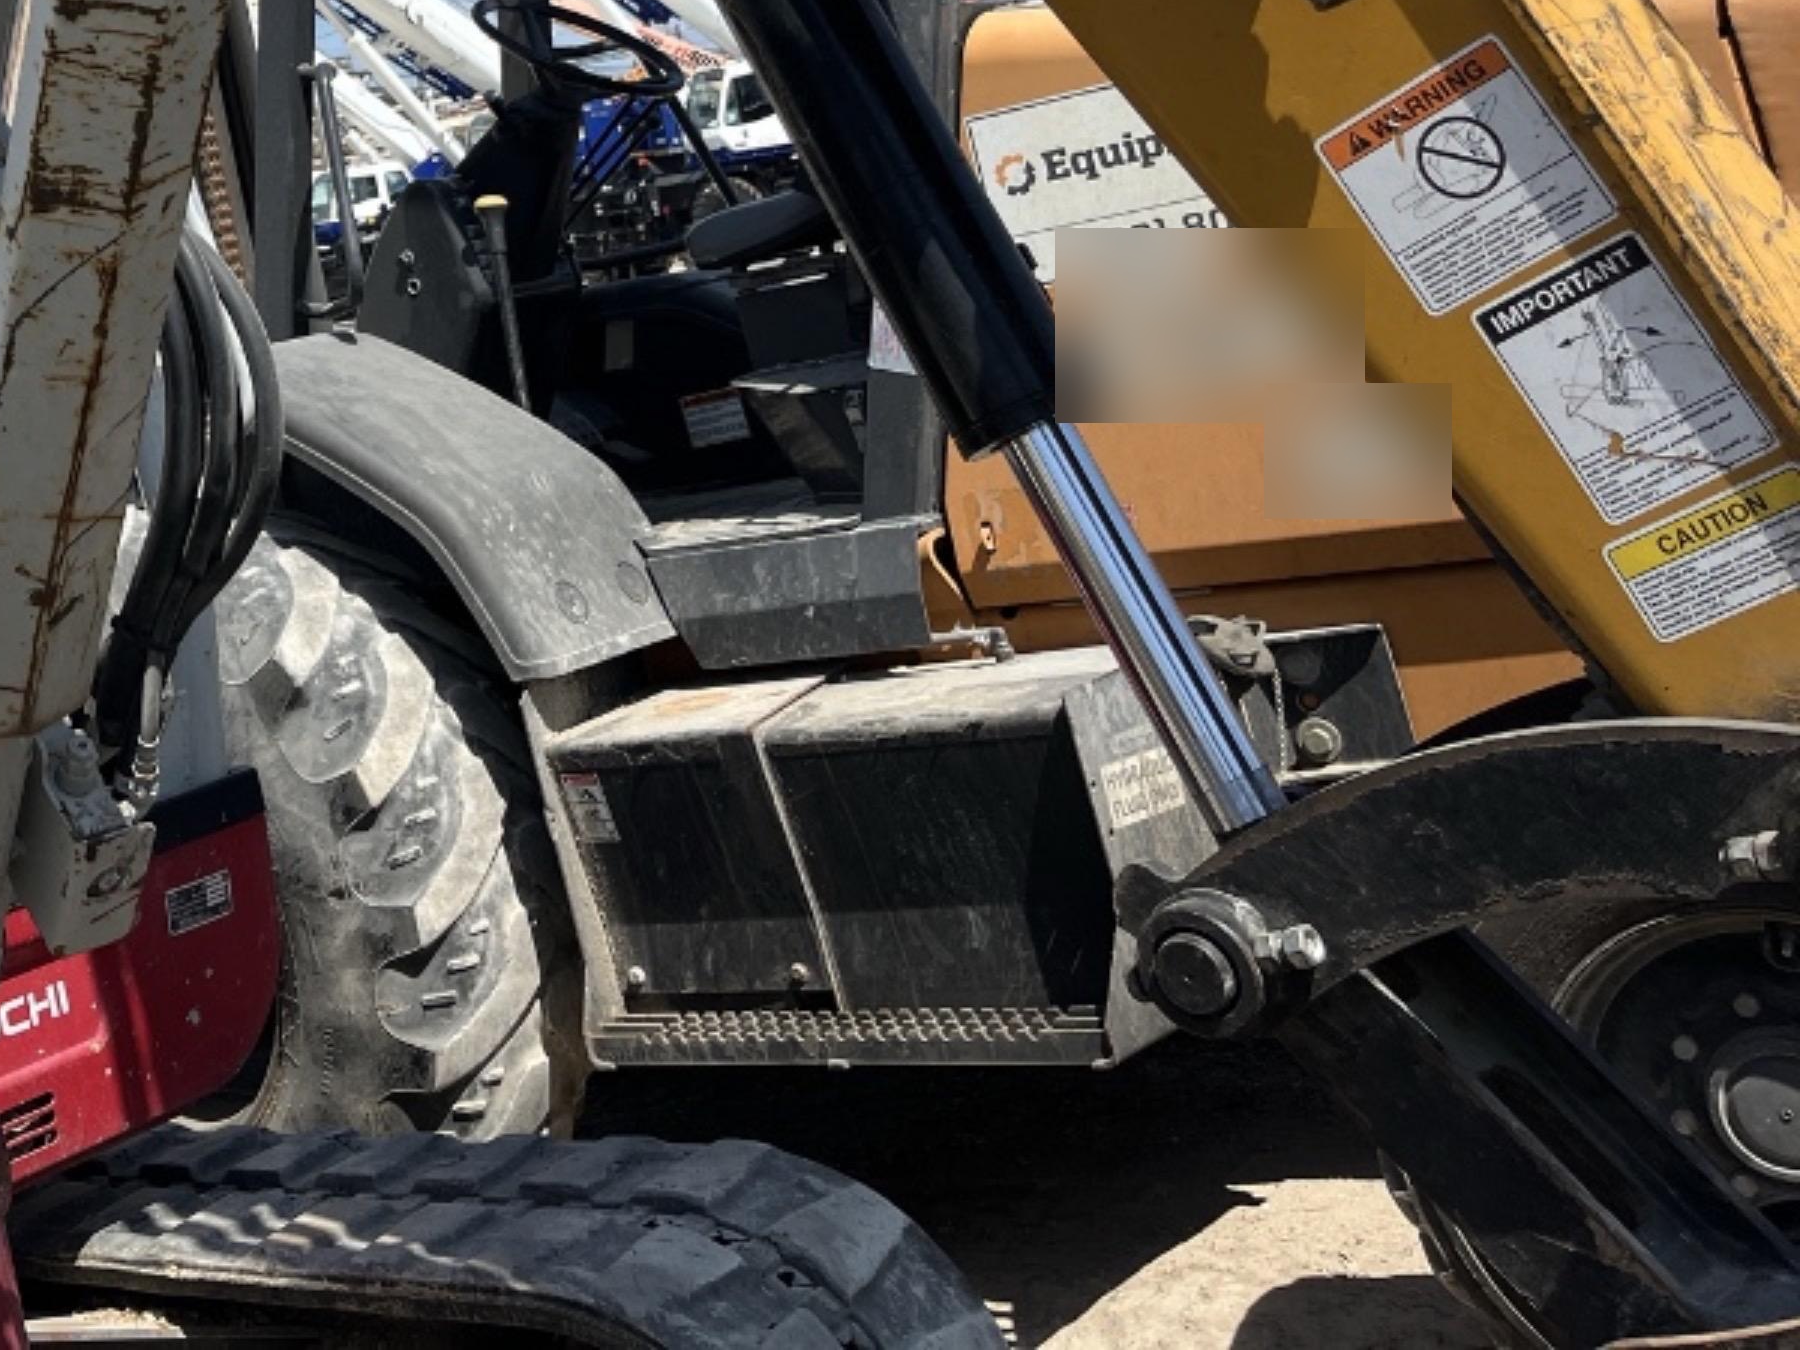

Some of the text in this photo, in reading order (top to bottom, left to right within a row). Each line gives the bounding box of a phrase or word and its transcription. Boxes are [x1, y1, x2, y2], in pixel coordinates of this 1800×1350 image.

[1368, 58, 1487, 141] WARNING
[1488, 247, 1632, 335] IMPORTANT
[1656, 491, 1769, 556] CAUTION
